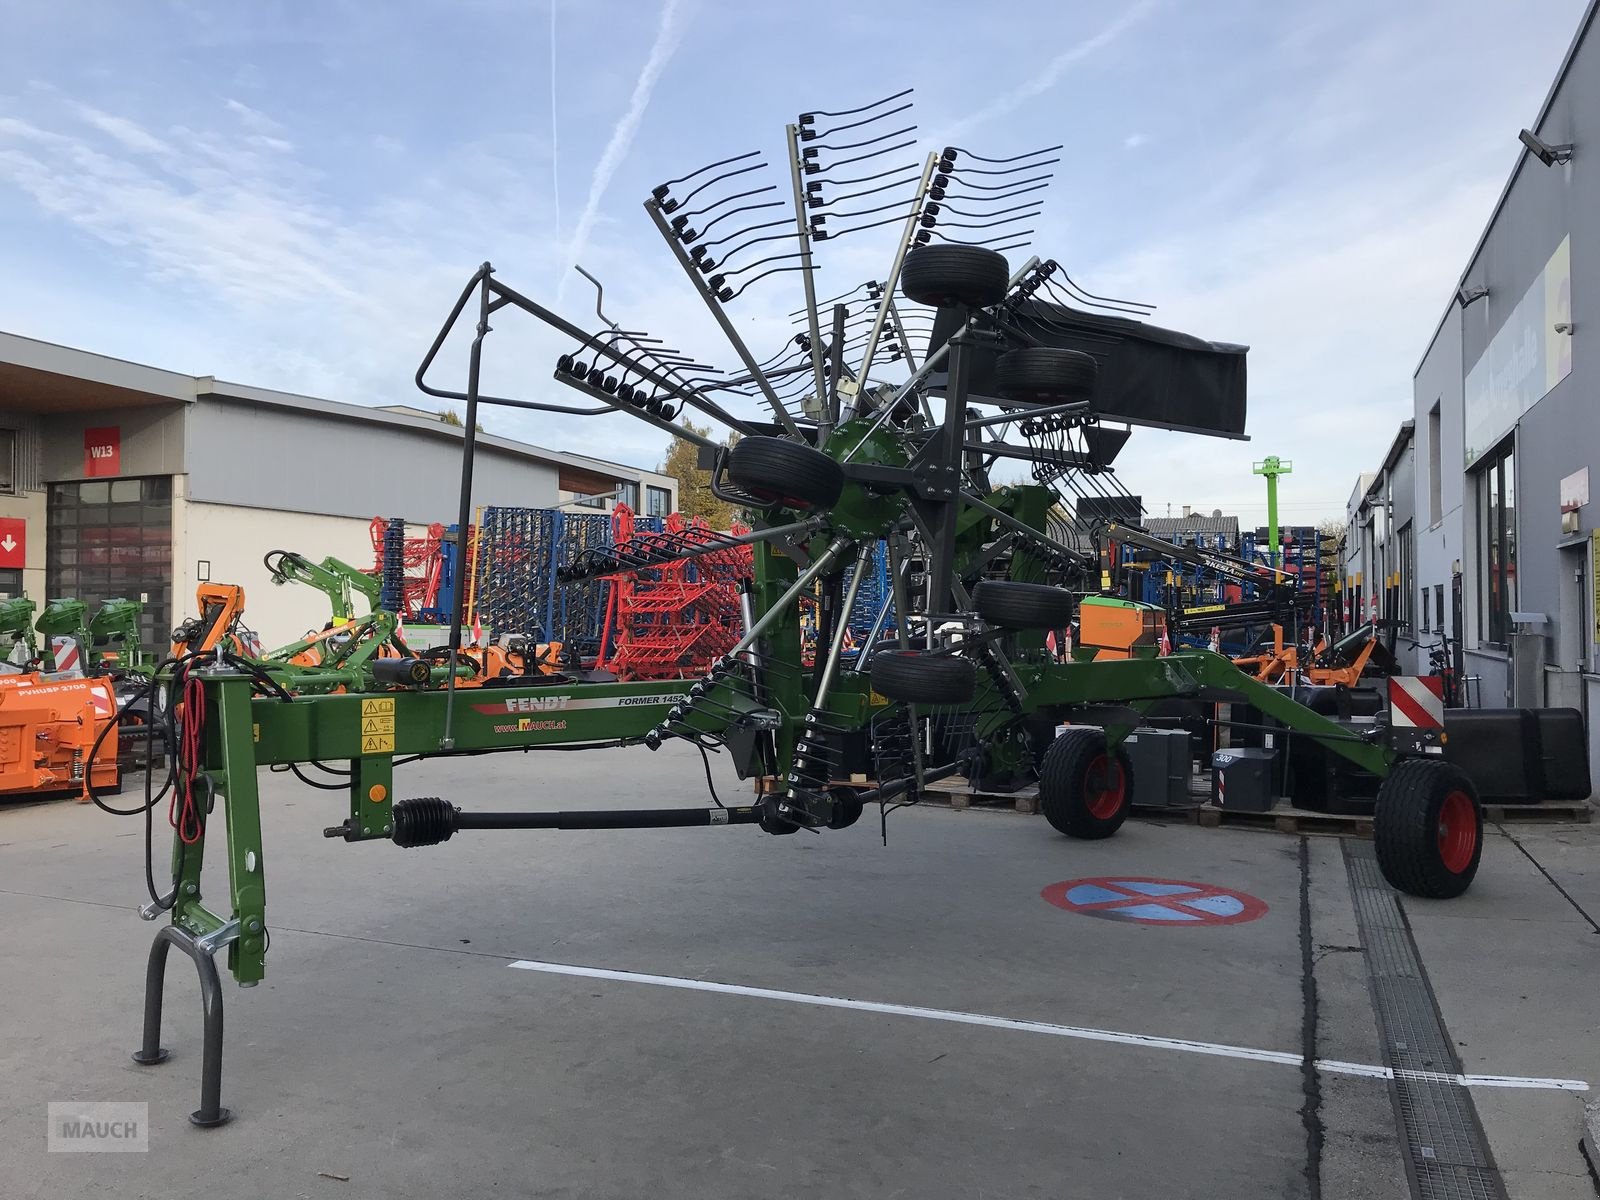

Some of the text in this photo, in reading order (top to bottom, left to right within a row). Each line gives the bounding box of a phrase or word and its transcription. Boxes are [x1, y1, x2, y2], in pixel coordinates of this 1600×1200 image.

[91, 445, 113, 458] W13
[60, 684, 86, 692] 2700
[505, 695, 571, 712] FENDT
[618, 695, 685, 706] FORMER 1452
[494, 719, 567, 734] www.MAUCH.at
[1216, 754, 1232, 762] 300
